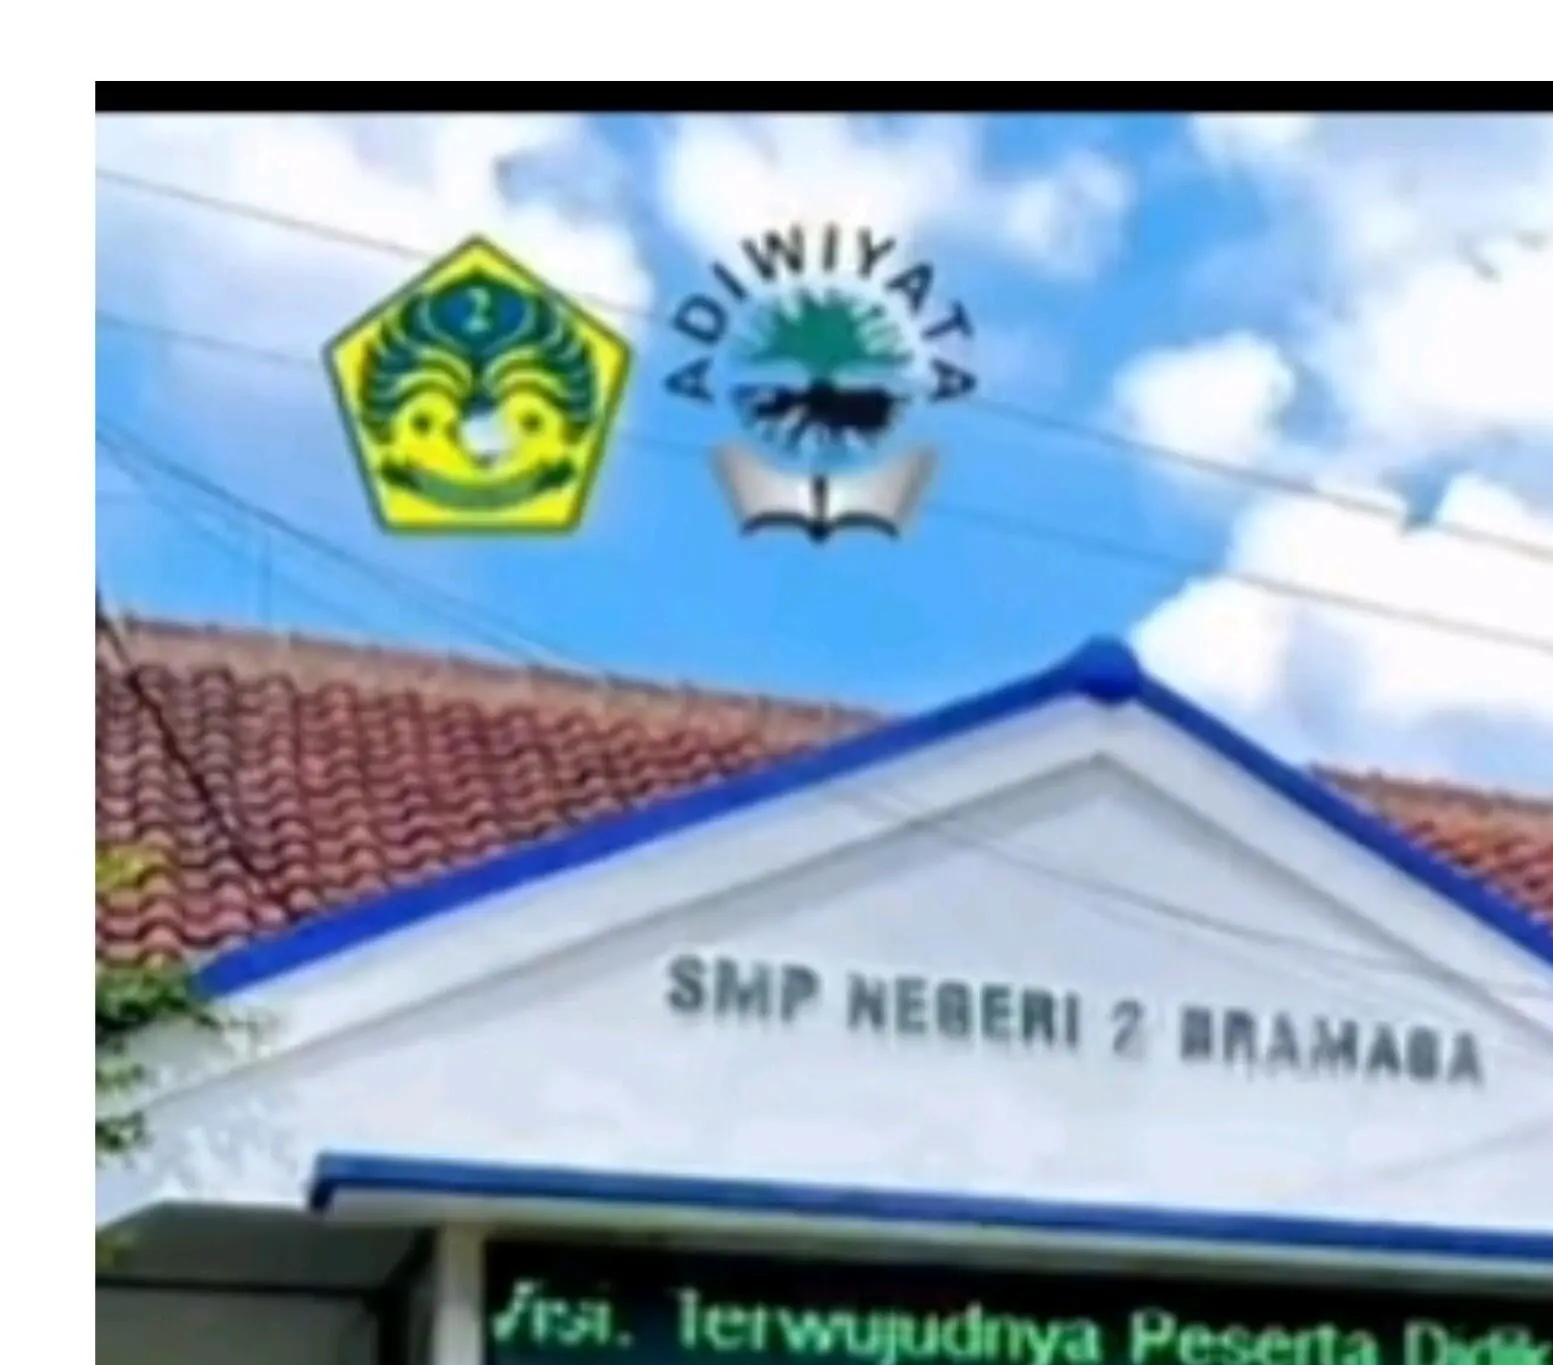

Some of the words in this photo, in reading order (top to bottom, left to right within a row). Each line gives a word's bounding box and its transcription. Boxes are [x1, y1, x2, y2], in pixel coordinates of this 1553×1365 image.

[665, 953, 821, 1026] SMP
[847, 971, 1083, 1051] NEGERI
[1110, 995, 1145, 1054] 2
